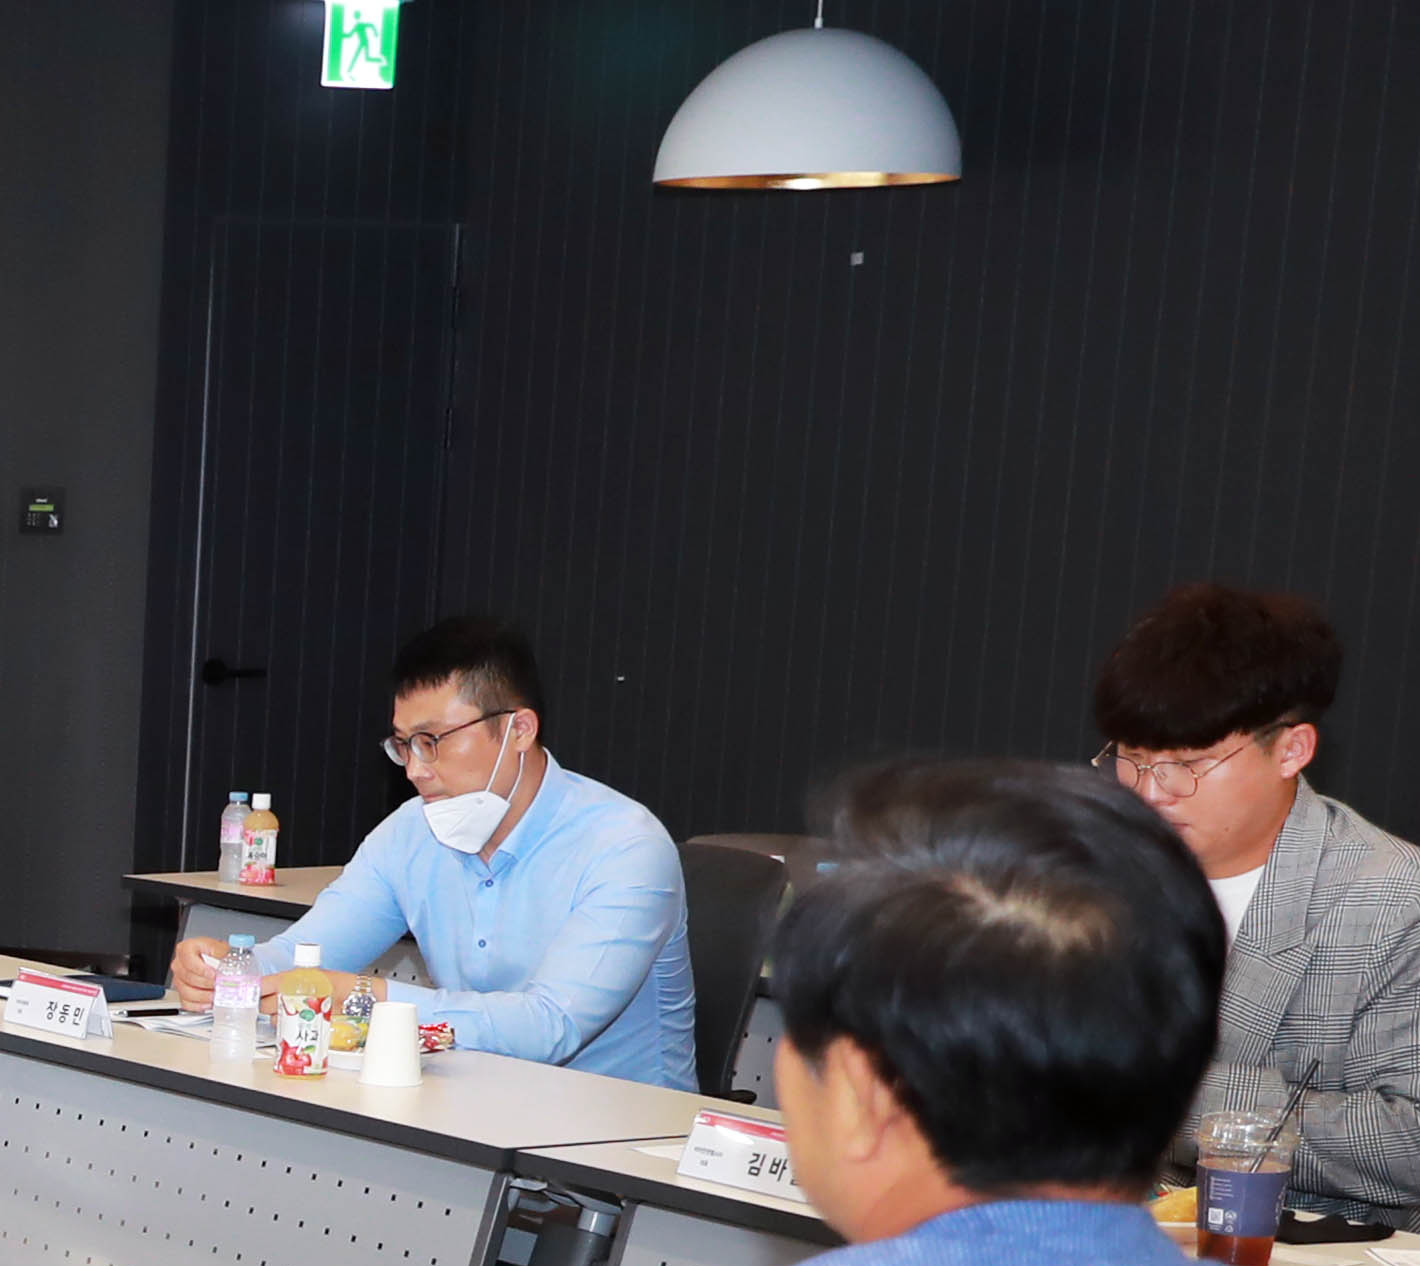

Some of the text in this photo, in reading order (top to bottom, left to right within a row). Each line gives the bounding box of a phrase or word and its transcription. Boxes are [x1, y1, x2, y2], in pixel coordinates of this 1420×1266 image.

[46, 1001, 85, 1026] 장동민
[295, 1029, 320, 1042] 사과
[747, 1152, 801, 1187] 김바
